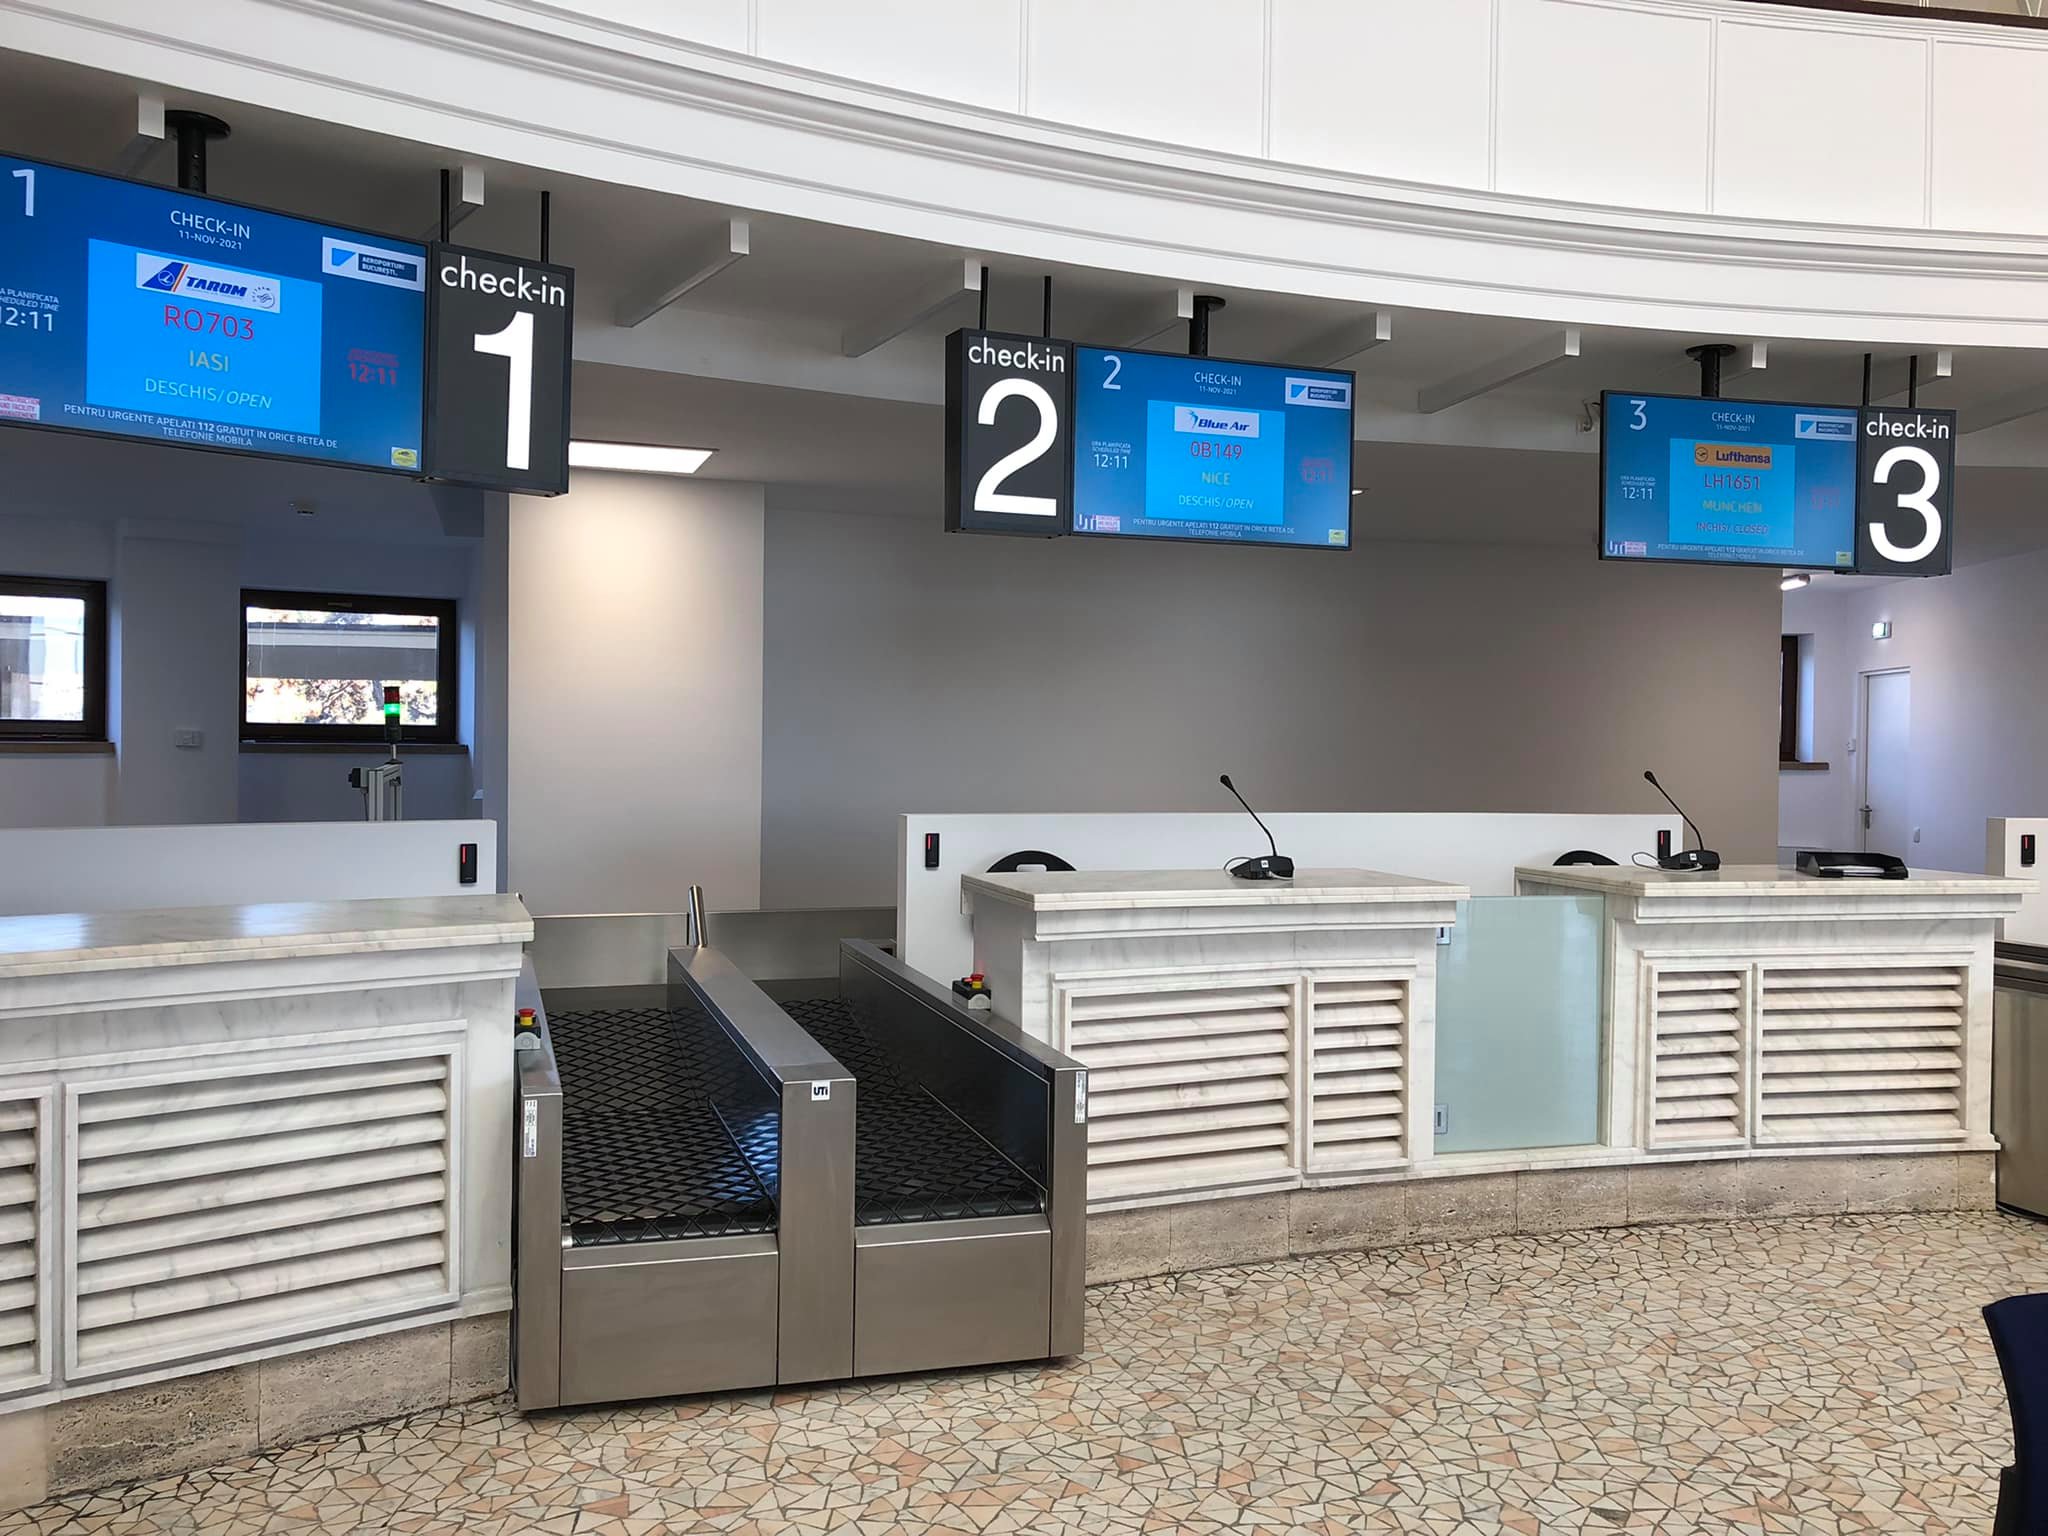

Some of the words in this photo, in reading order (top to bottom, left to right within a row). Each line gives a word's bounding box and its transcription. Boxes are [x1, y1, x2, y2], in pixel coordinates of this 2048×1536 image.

[12, 169, 35, 217] 1
[170, 210, 251, 240] CHECK-IN
[178, 230, 242, 251] 11-NOV-2021
[186, 276, 248, 297] TAROM
[440, 255, 565, 307] check-in
[7, 288, 60, 304] PLANIFICATA
[164, 304, 254, 341] RO703
[189, 350, 229, 372] IASI
[968, 337, 1065, 373] check-in
[1102, 354, 1122, 390] 2
[1194, 371, 1242, 386] CHECK-IN
[474, 311, 534, 470] 1
[64, 404, 105, 418] PENTRU
[107, 411, 155, 425] URGENTE
[156, 416, 196, 430] APELATI
[198, 422, 215, 433] 112
[216, 424, 255, 438] GRATUIT
[256, 431, 267, 439] IN
[268, 432, 296, 444] ORICE
[297, 435, 325, 448] RETEA
[326, 439, 338, 449] DE
[1197, 418, 1228, 430] Blue
[1230, 421, 1250, 432] Air
[1629, 400, 1648, 431] 3
[1711, 411, 1756, 424] CHECK-IN
[1866, 412, 1950, 440] check-in
[163, 427, 214, 441] TELEFONIE
[216, 434, 253, 446] MOBILA
[974, 378, 1058, 517] 2
[1093, 453, 1128, 469] 12:11
[1715, 450, 1771, 464] Lufthansa
[1201, 471, 1231, 486] NICE
[1703, 473, 1761, 491] LH1651
[1622, 486, 1653, 500] 12:11
[1869, 446, 1942, 562] 3
